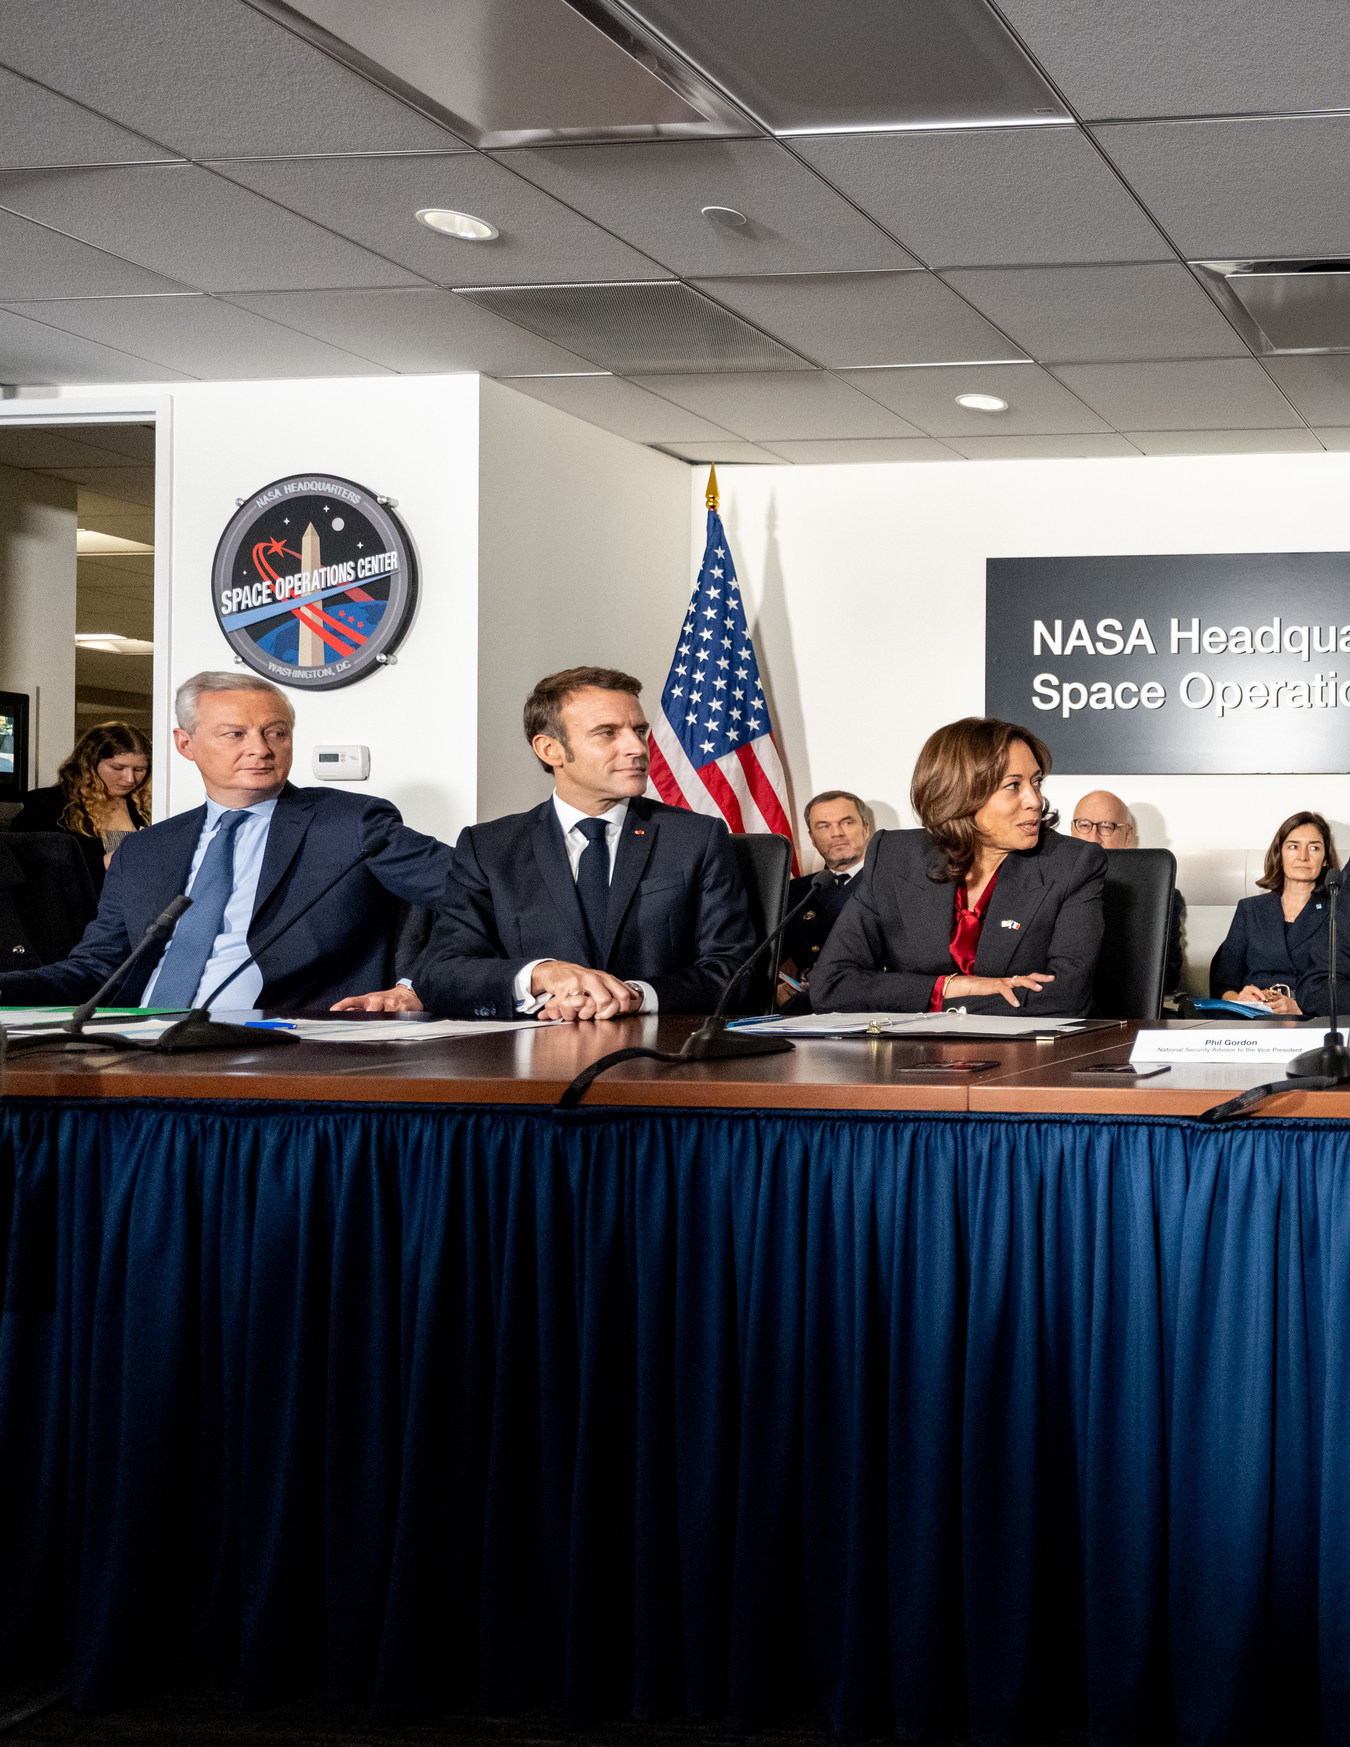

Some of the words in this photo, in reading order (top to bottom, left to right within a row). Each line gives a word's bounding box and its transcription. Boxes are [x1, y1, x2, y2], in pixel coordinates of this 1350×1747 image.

[255, 488, 282, 509] NASA
[284, 481, 362, 505] HEADQUARTERS
[221, 580, 273, 615] SPACE
[275, 560, 356, 599] OPERATIONS
[357, 551, 398, 578] CENTER
[1032, 618, 1156, 656] NASA
[267, 661, 336, 680] WASHINGTON,
[336, 660, 352, 674] DC
[1031, 672, 1166, 719] Space
